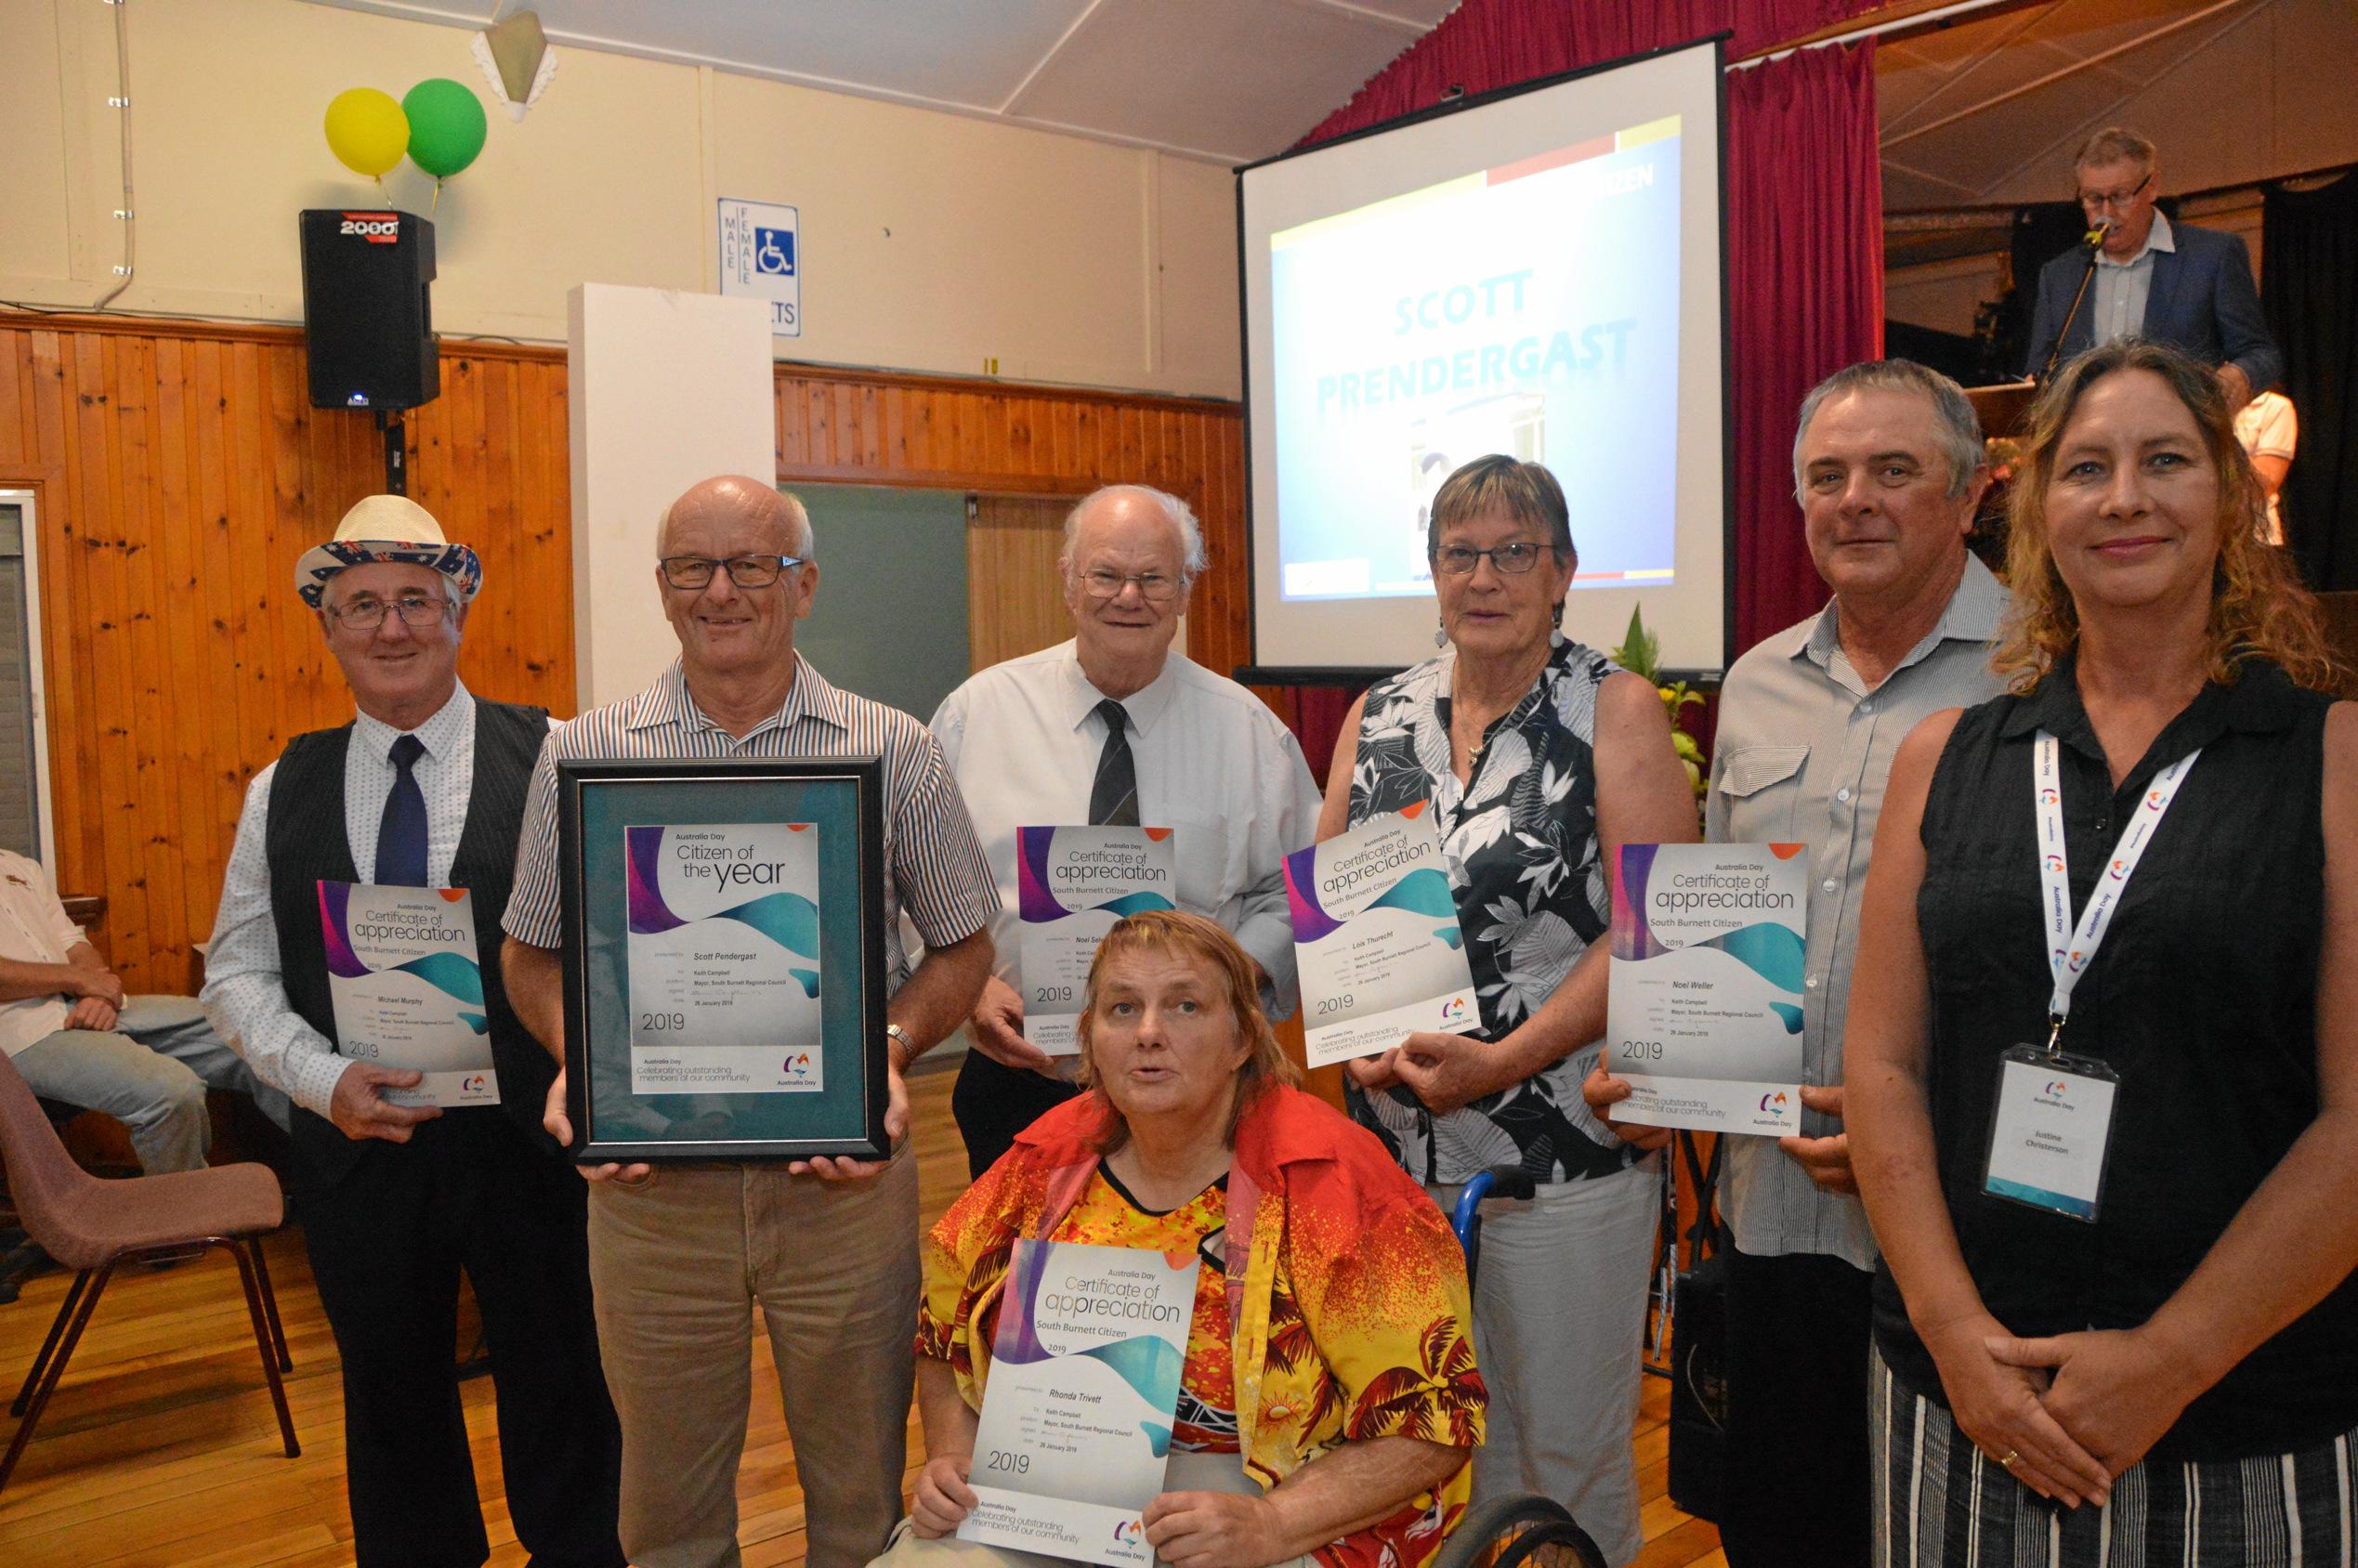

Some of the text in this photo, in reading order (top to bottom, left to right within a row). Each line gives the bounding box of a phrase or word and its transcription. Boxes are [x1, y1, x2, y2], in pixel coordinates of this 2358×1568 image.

[725, 217, 736, 268] MALE
[740, 207, 752, 285] FEMALE
[1394, 268, 1533, 336] SCOTT
[1317, 318, 1637, 412] PRENDERGAST
[2042, 764, 2051, 776] Day
[710, 833, 726, 842] Day
[1364, 830, 1401, 847] Australia Day
[676, 844, 754, 860] Citizen of
[1069, 851, 1147, 865] Certificate of
[1333, 834, 1408, 872] Certificate of
[1055, 864, 1166, 883] appreciation
[1323, 842, 1431, 894] appreciation
[1749, 864, 1764, 872] Day
[684, 862, 785, 894] the year
[1673, 874, 1770, 889] Certificate of
[1323, 878, 1397, 909] South Burnett Citizen
[1656, 889, 1794, 913] appreciation
[2053, 886, 2063, 917] Australia
[425, 904, 437, 912] Day
[1339, 910, 1355, 920] 2019
[2086, 893, 2112, 939] Australia Day
[365, 909, 443, 926] Certificate of
[1650, 919, 1743, 927] South Burnett Citizen
[355, 922, 465, 942] appreciation
[1352, 931, 1394, 950] Lois Thurecht
[373, 946, 400, 955] Burnett
[401, 947, 426, 956] Citizen
[693, 952, 714, 960] Scott
[714, 952, 757, 961] Pendergast
[1691, 981, 1714, 989] Weller
[400, 997, 423, 1006] Murphy
[1037, 987, 1072, 1002] 2019
[1317, 994, 1354, 1015] 2019
[642, 1013, 685, 1030] 2019
[1316, 1035, 1356, 1050] Celebrating
[1356, 1026, 1398, 1040] outstanding
[348, 1040, 379, 1058] 2019
[1318, 1043, 1353, 1055] members
[1353, 1040, 1361, 1049] of
[1622, 1040, 1663, 1060] 2019
[636, 1066, 732, 1076] Celebrating outstanding
[639, 1074, 678, 1082] members
[679, 1074, 688, 1082] of
[705, 1074, 751, 1083] community
[1660, 1099, 1708, 1109] outstanding
[2062, 1103, 2076, 1112] Day
[1680, 1107, 1726, 1119] community
[2035, 1130, 2062, 1142] Justine
[1108, 1269, 1156, 1281] Australia Day
[1065, 1276, 1160, 1300] Certificate of
[1045, 1293, 1180, 1323] appreciation
[1036, 1320, 1127, 1339] South Burnett Citizen
[1048, 1343, 1067, 1353] 2019
[1049, 1389, 1077, 1401] Rhonda
[1079, 1393, 1102, 1404] Trivett
[1058, 1410, 1081, 1418] Campbell
[1060, 1421, 1074, 1430] South
[1075, 1423, 1093, 1431] Burnett
[1093, 1426, 1114, 1435] Regional
[1114, 1429, 1133, 1437] Council
[1046, 1444, 1066, 1452] January
[988, 1450, 1029, 1474] 2019
[980, 1501, 1004, 1510] Australia
[971, 1509, 1064, 1533] Celebrating outstanding
[972, 1518, 1080, 1546] members of our community
[1105, 1548, 1146, 1561] Australia Day
